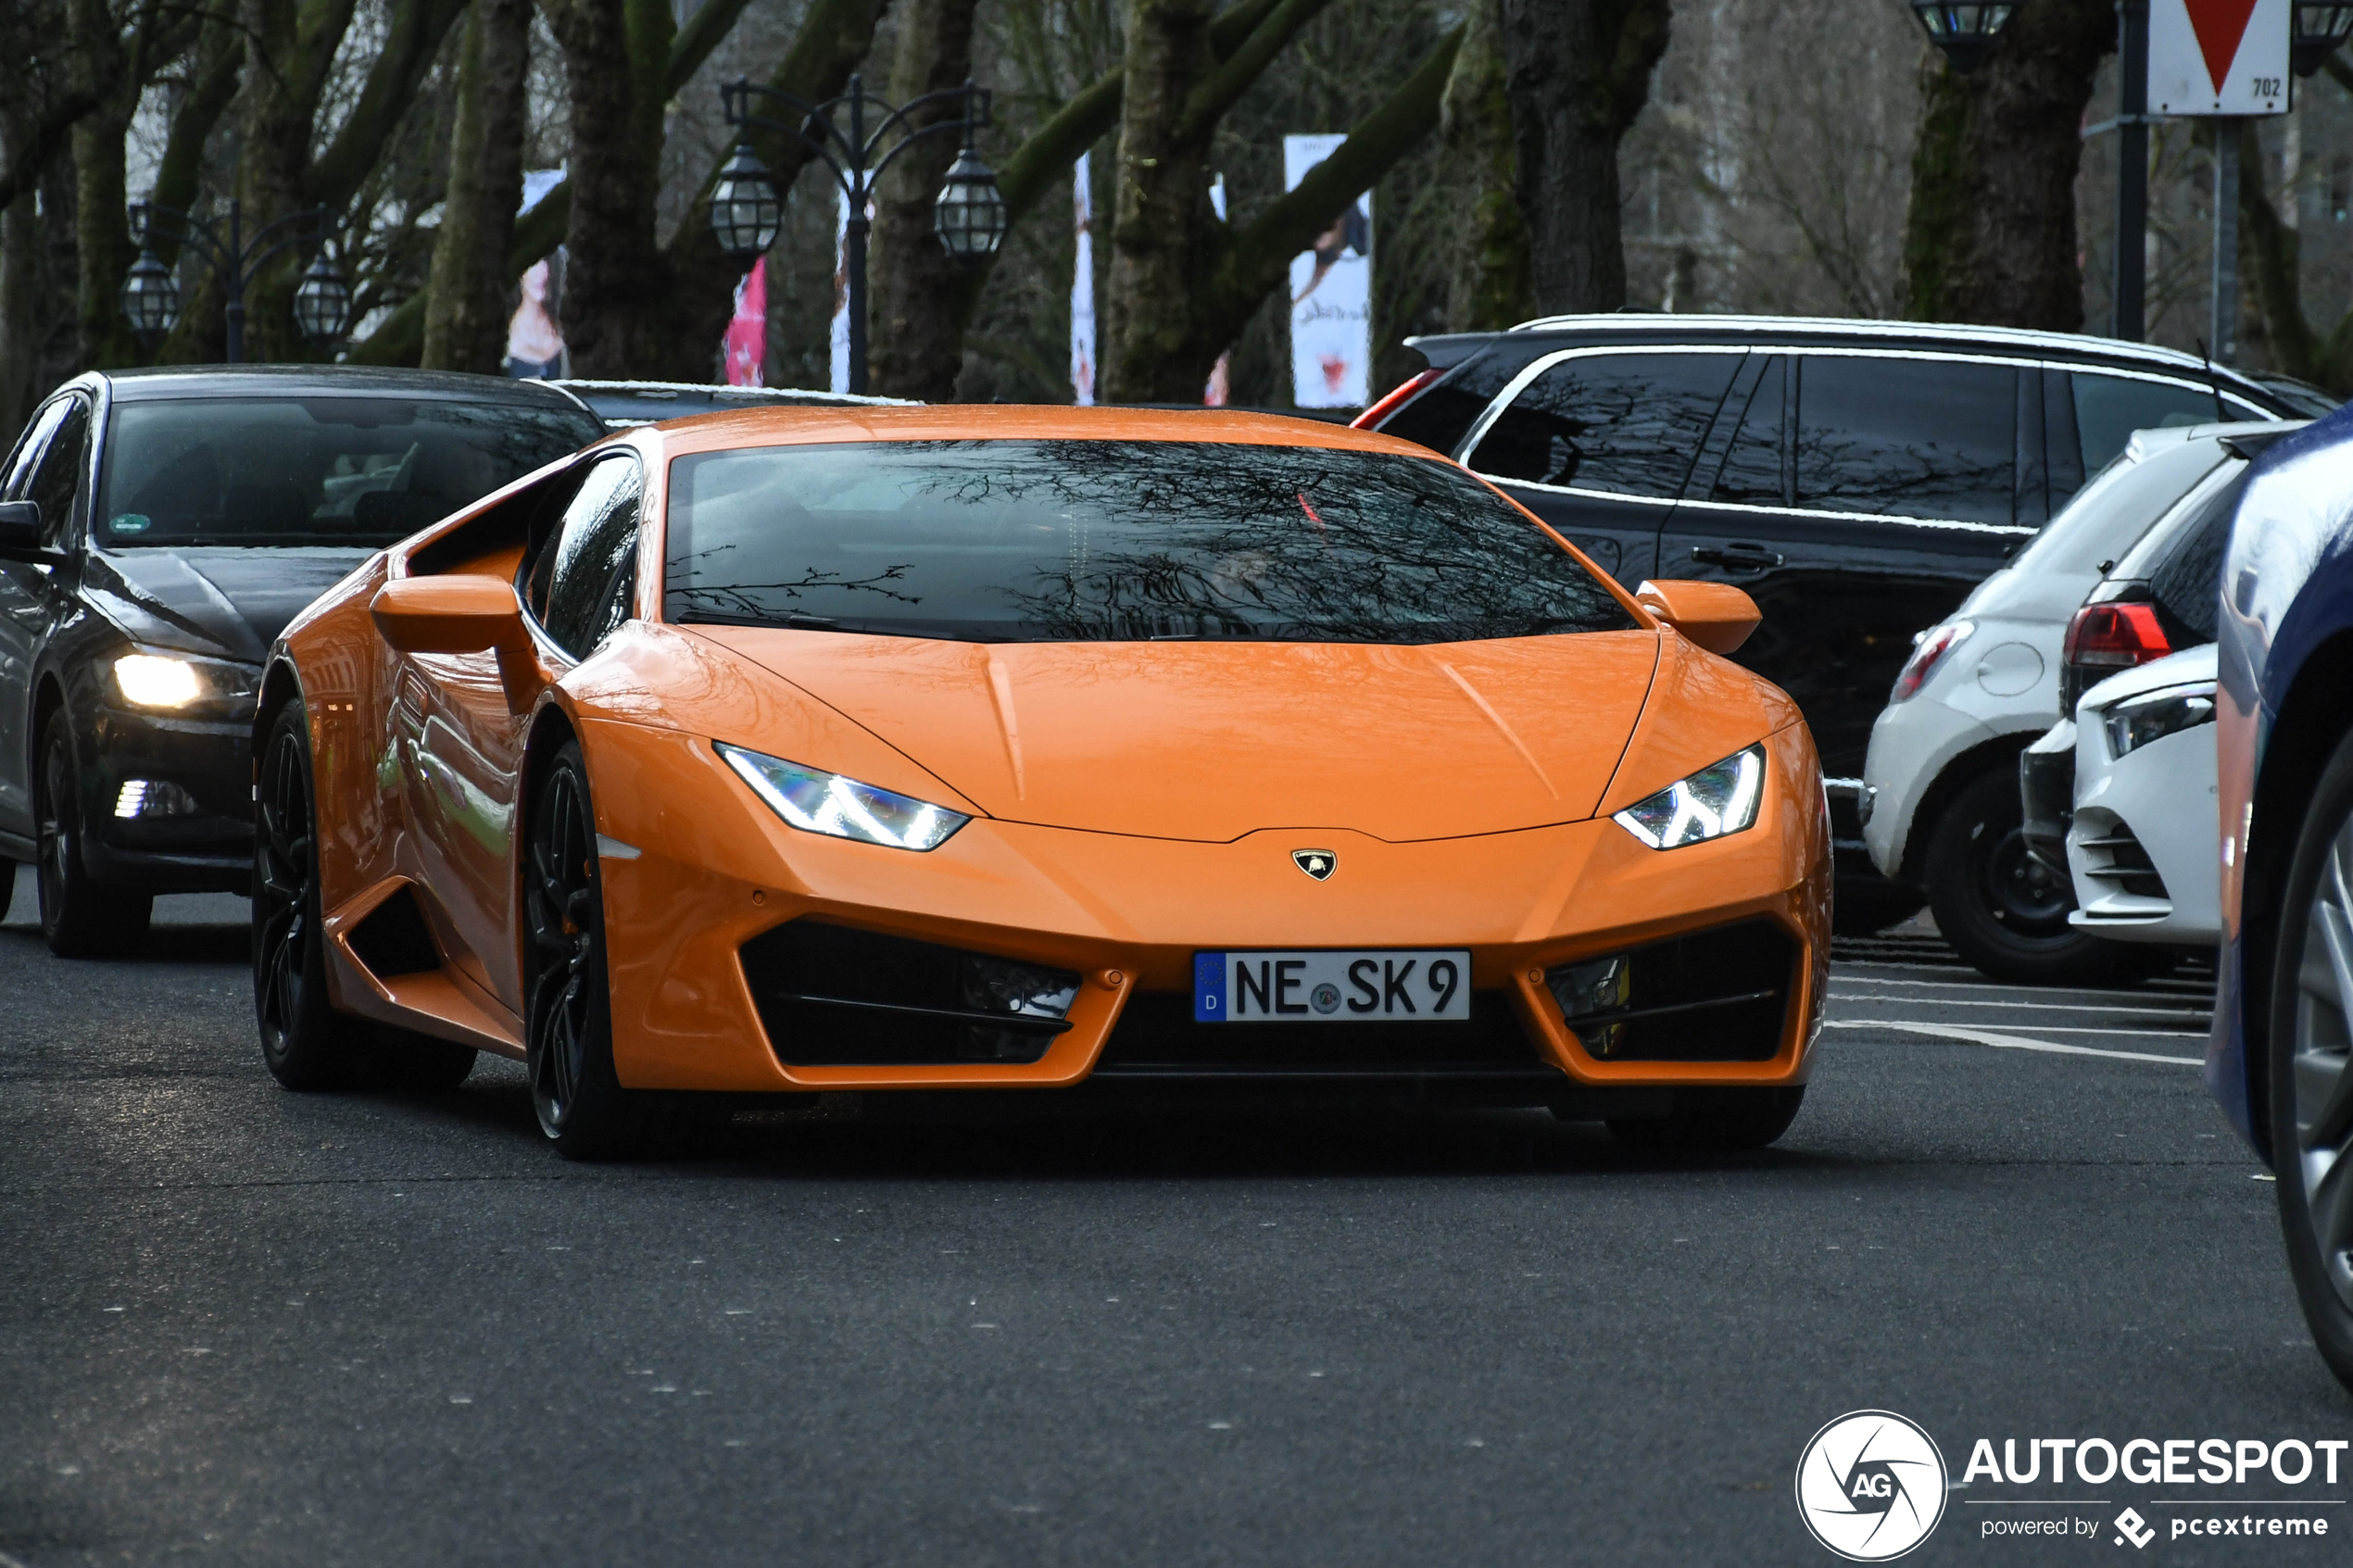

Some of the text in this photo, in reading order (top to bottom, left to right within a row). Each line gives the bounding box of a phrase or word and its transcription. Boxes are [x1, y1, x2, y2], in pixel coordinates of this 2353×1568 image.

[2253, 78, 2281, 97] 702
[1237, 960, 1458, 1013] NE SK 9
[1205, 995, 1217, 1010] D
